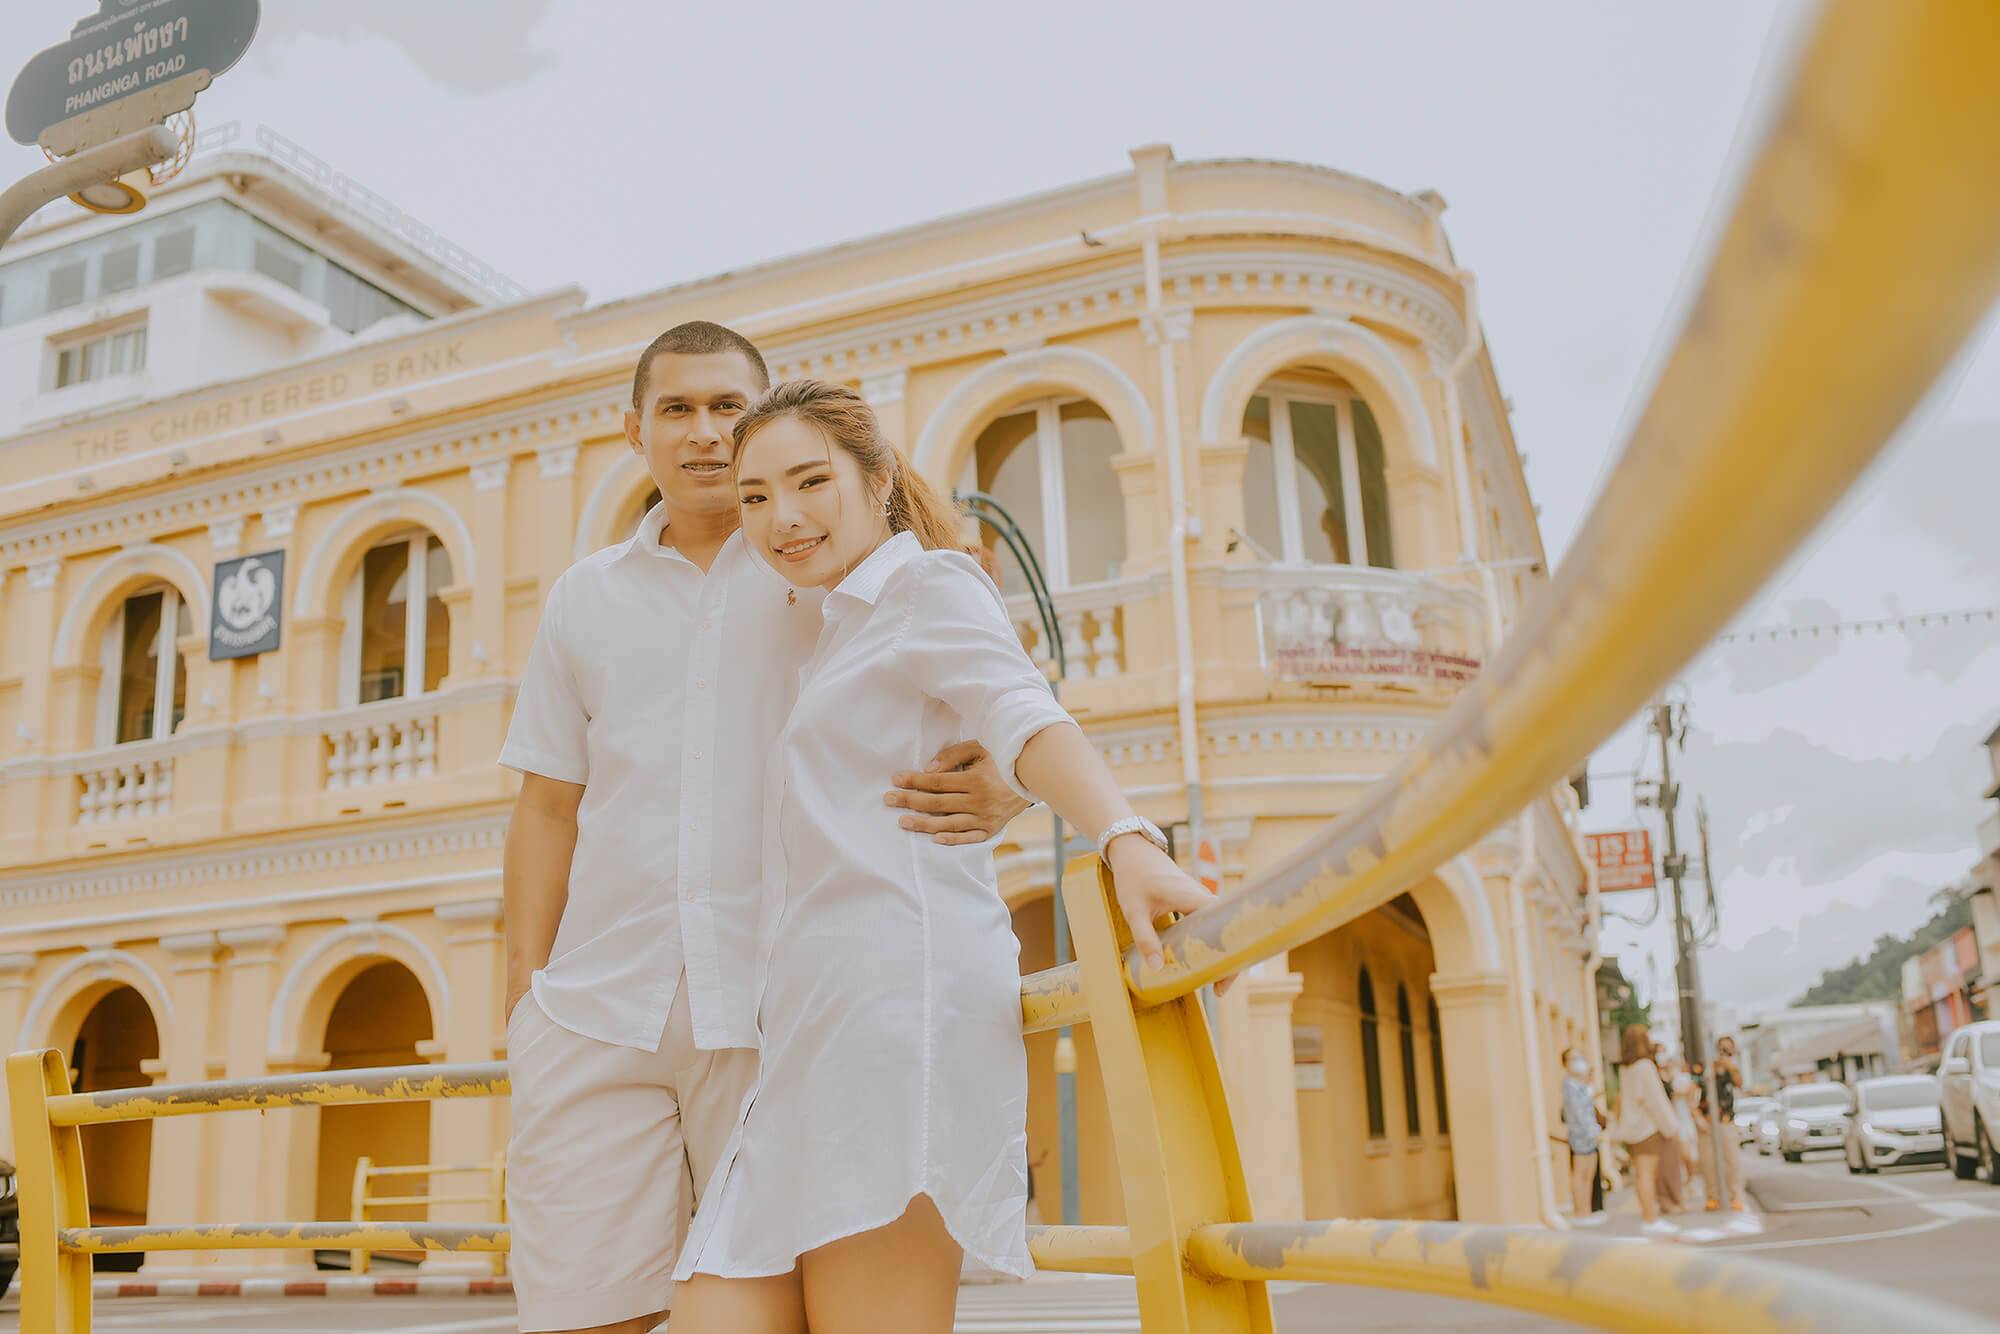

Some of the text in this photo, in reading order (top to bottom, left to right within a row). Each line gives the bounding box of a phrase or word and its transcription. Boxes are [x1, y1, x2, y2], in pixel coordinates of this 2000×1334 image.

[65, 54, 186, 114] PHANGNGA ROAD
[68, 16, 189, 85] ถนนพังงา
[74, 342, 465, 462] THE CHARTERED BANK
